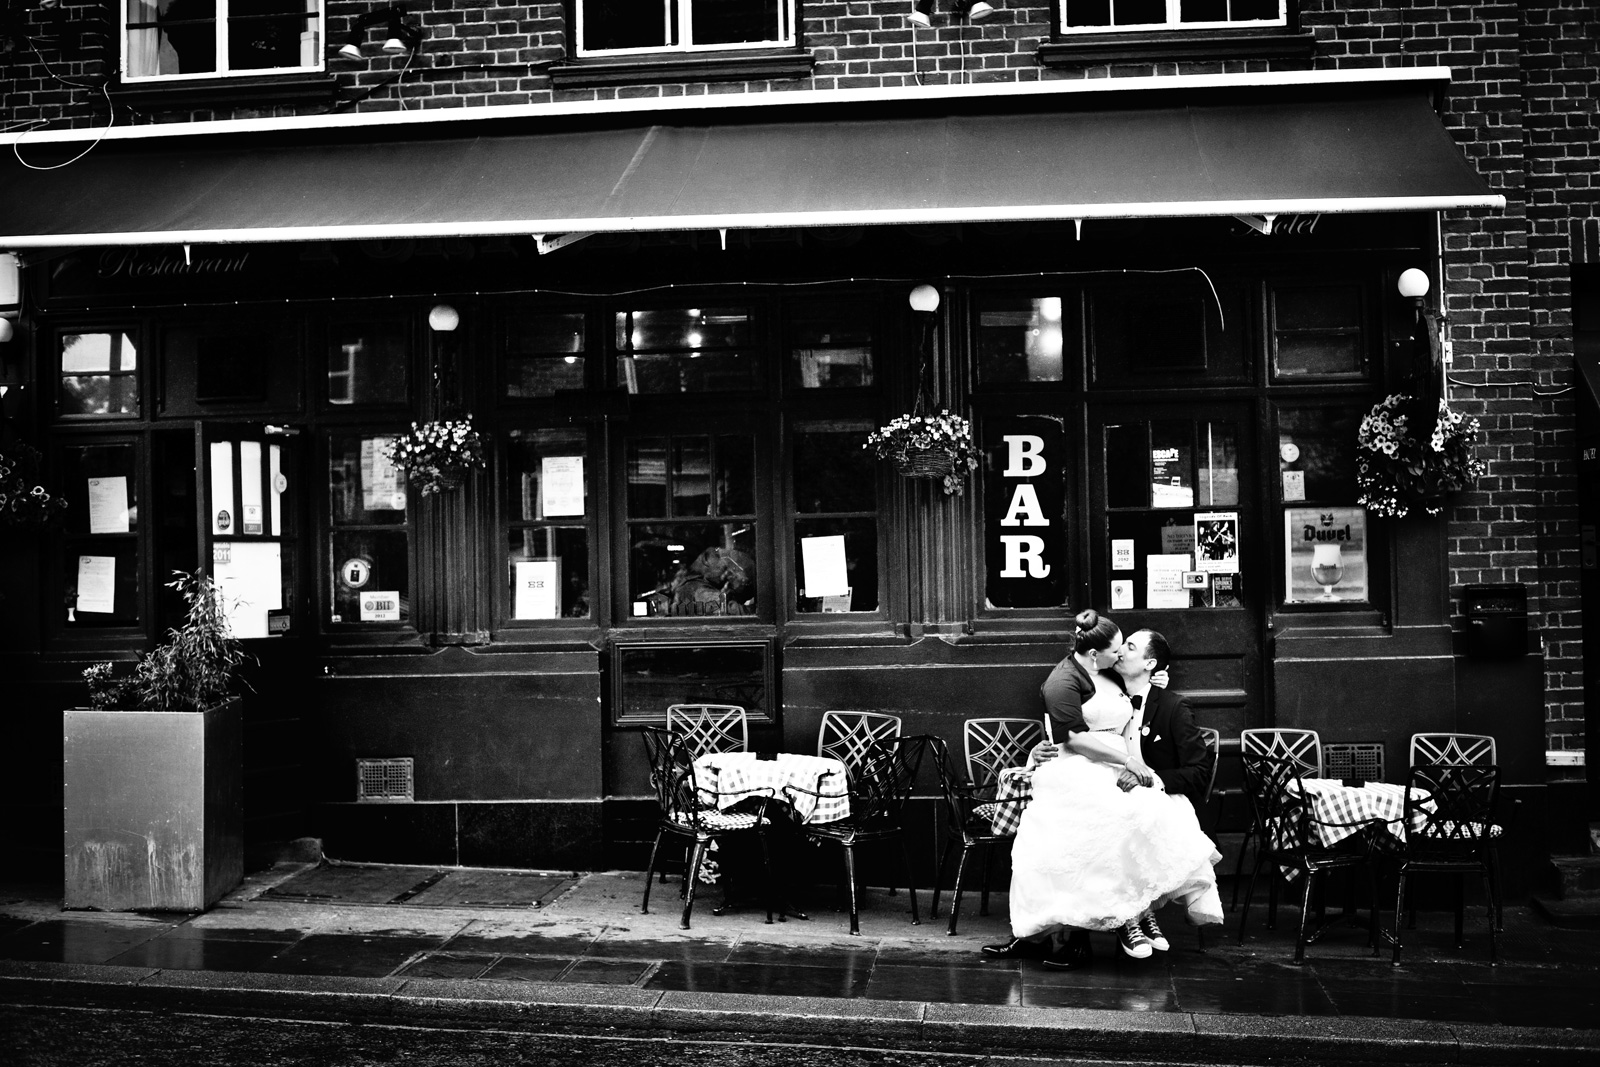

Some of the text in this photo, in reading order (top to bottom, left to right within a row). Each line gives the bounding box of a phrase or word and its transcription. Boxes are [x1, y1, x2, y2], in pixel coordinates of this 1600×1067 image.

[97, 245, 250, 279] Restaurant
[999, 434, 1051, 579] BAR
[1303, 524, 1351, 542] Duvel
[212, 549, 231, 560] 2011
